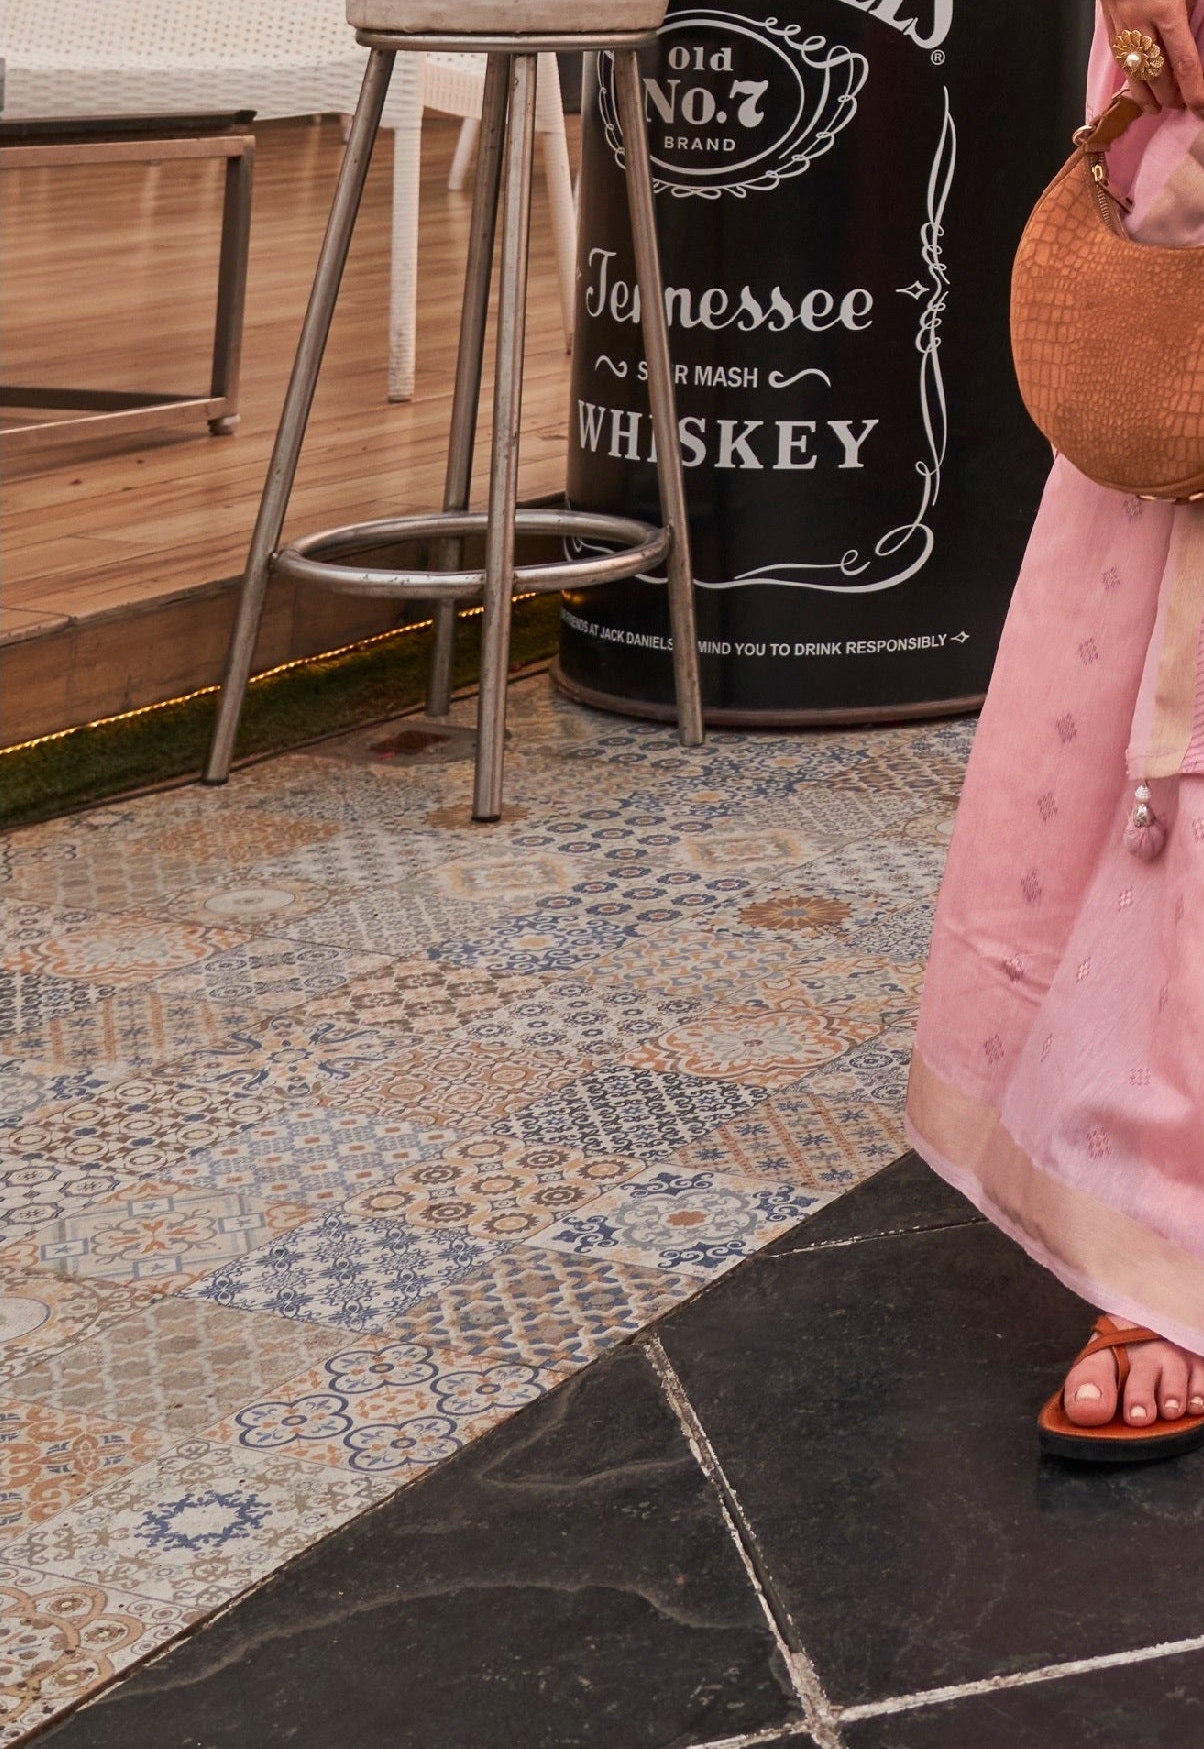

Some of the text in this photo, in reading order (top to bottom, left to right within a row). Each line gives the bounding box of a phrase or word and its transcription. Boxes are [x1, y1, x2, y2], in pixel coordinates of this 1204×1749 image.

[664, 136, 736, 151] BRAND
[637, 361, 758, 388] SR MASH
[589, 623, 600, 636] AT
[600, 627, 625, 643] JACK
[697, 640, 731, 655] MIND
[735, 642, 766, 656] YOU
[770, 643, 791, 656] TO
[794, 642, 842, 656] DRINK
[846, 633, 947, 654] RESPONSIBLY
